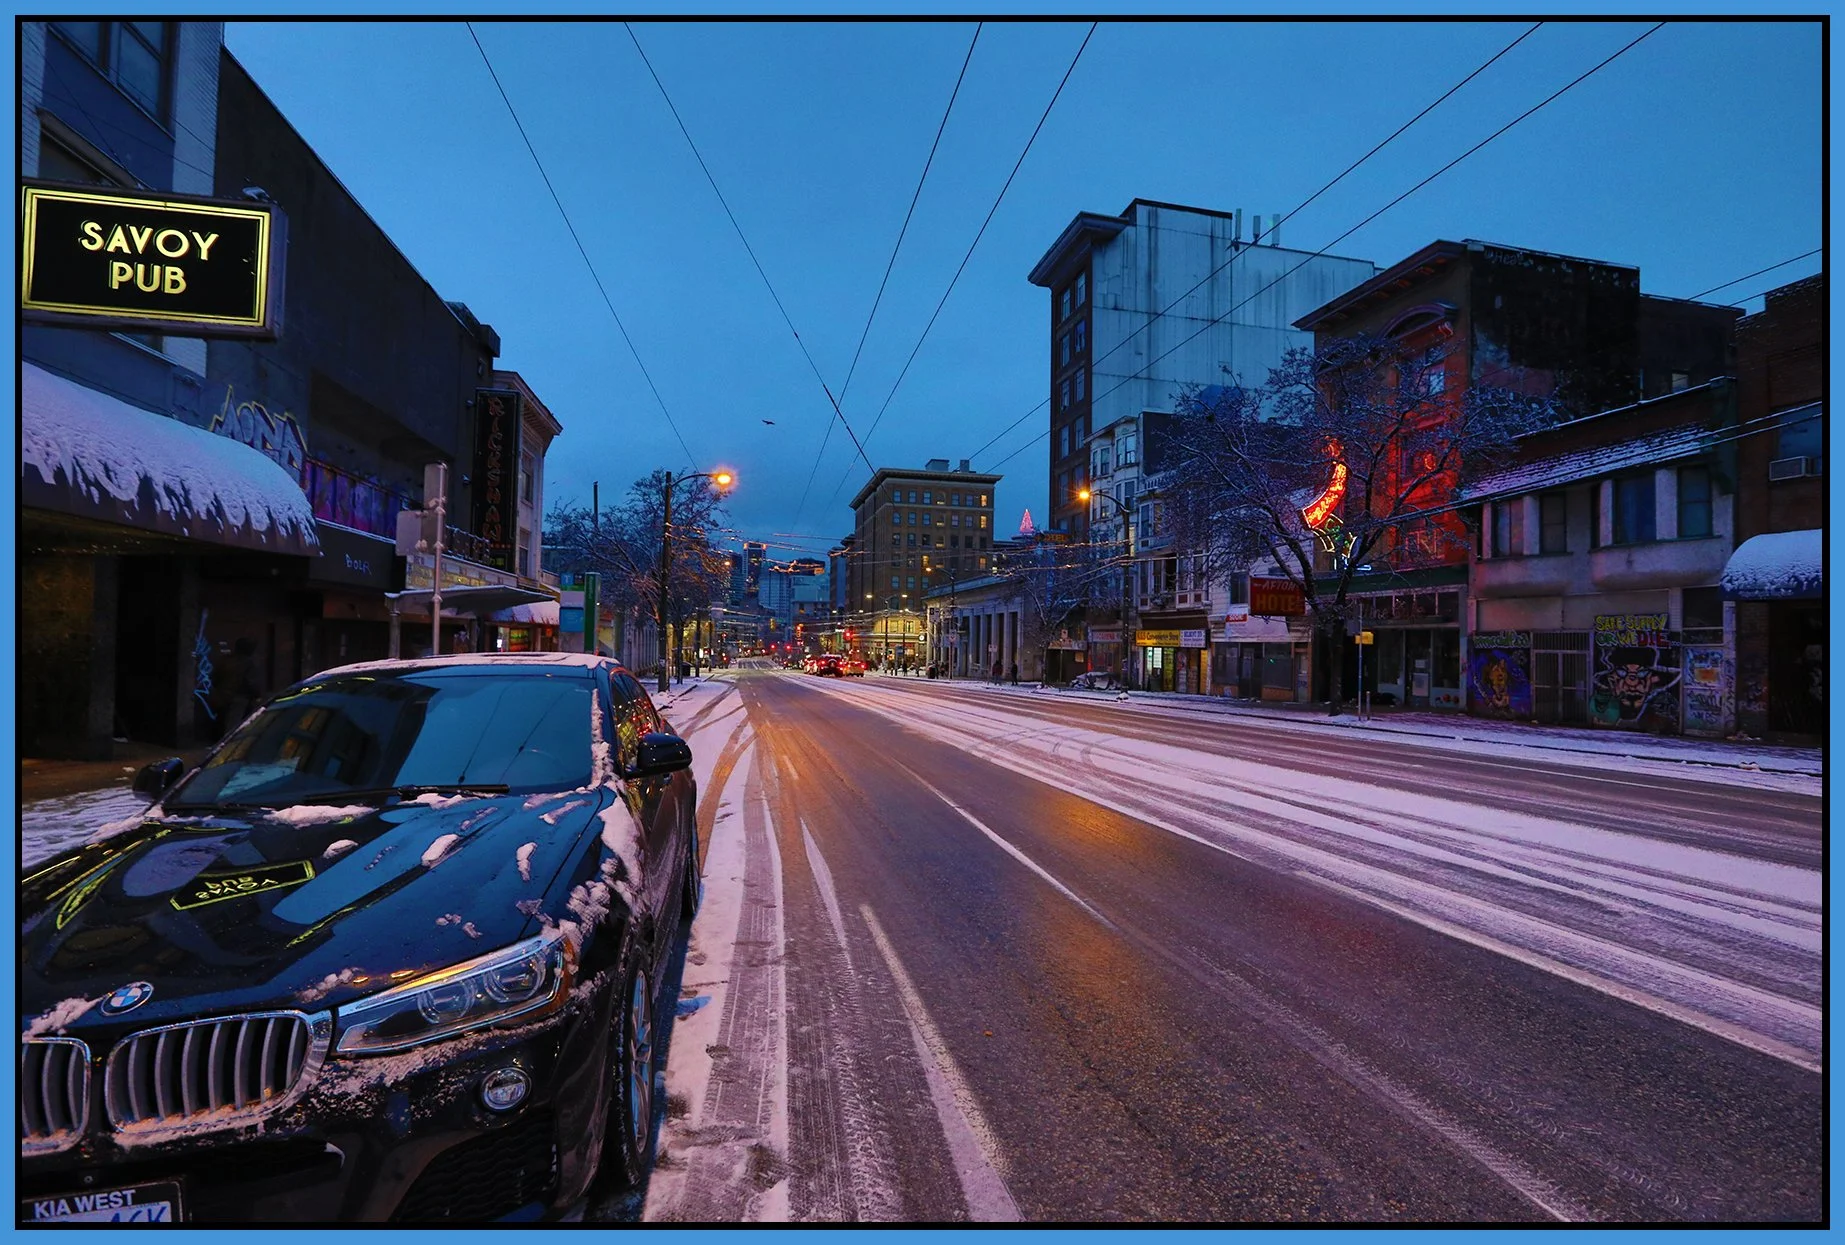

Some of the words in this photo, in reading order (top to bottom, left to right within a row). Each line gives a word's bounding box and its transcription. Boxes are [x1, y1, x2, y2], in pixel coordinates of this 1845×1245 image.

[77, 219, 220, 261] SAVOY
[107, 259, 188, 295] PUB
[1261, 580, 1296, 592] AFTON
[1595, 615, 1625, 632] SAFE
[34, 1199, 72, 1219] KIA
[74, 1189, 136, 1213] WEST
